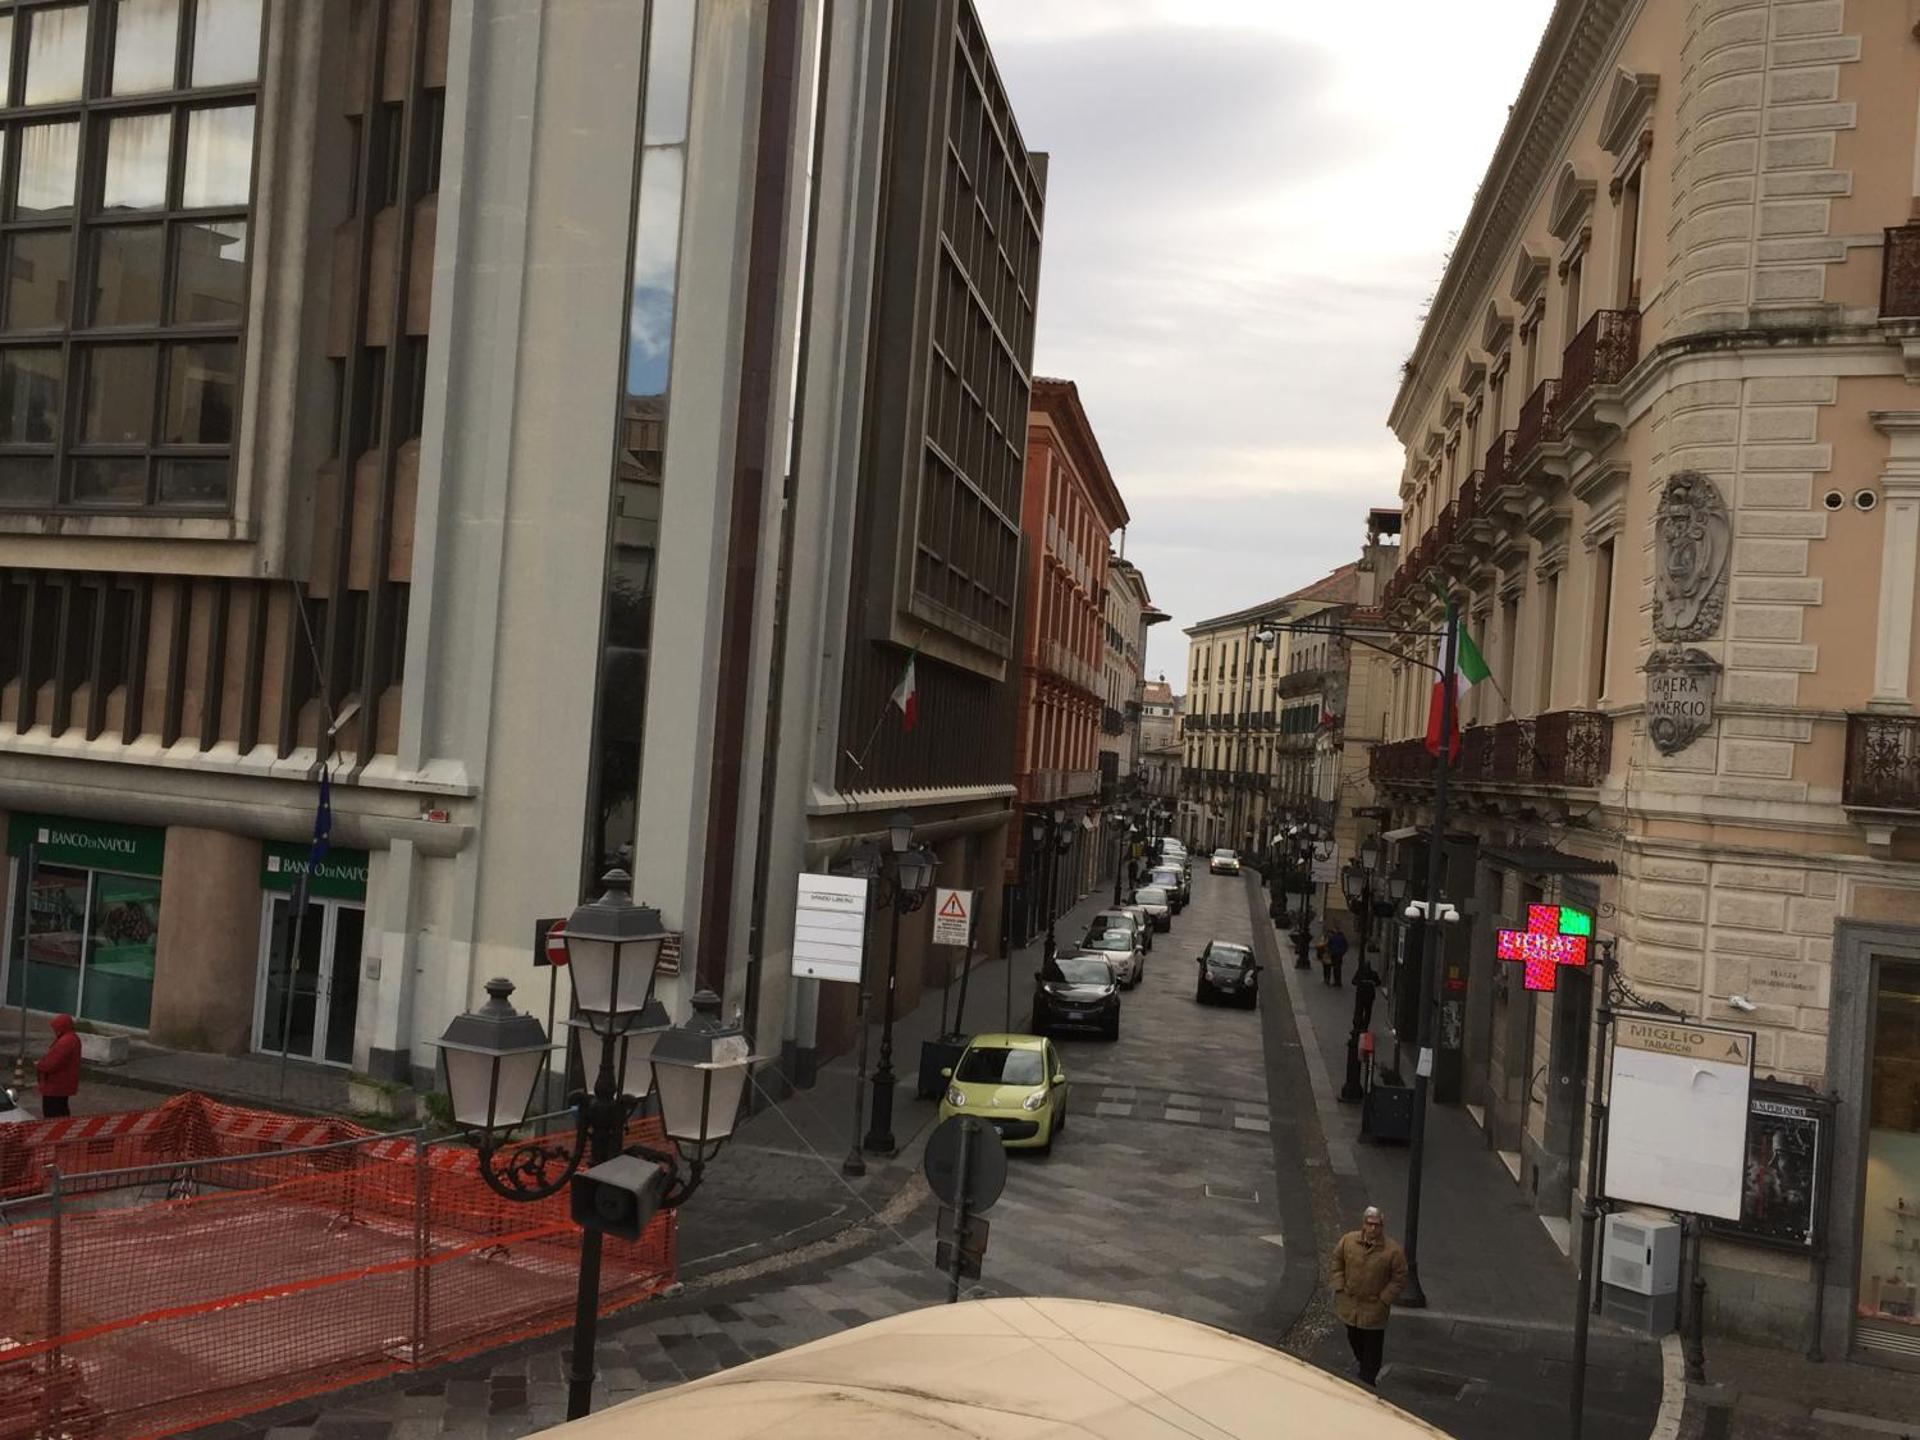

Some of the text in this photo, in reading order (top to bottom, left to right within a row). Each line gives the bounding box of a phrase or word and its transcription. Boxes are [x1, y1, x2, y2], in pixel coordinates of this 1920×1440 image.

[1653, 677, 1698, 693] CAMERA
[1663, 691, 1673, 701] DI
[1648, 700, 1705, 716] OMMERCIO
[52, 831, 88, 847] BANCO
[98, 837, 136, 853] NAPOLI
[337, 866, 368, 881] NAPO
[1643, 1040, 1692, 1053] TABACCHI
